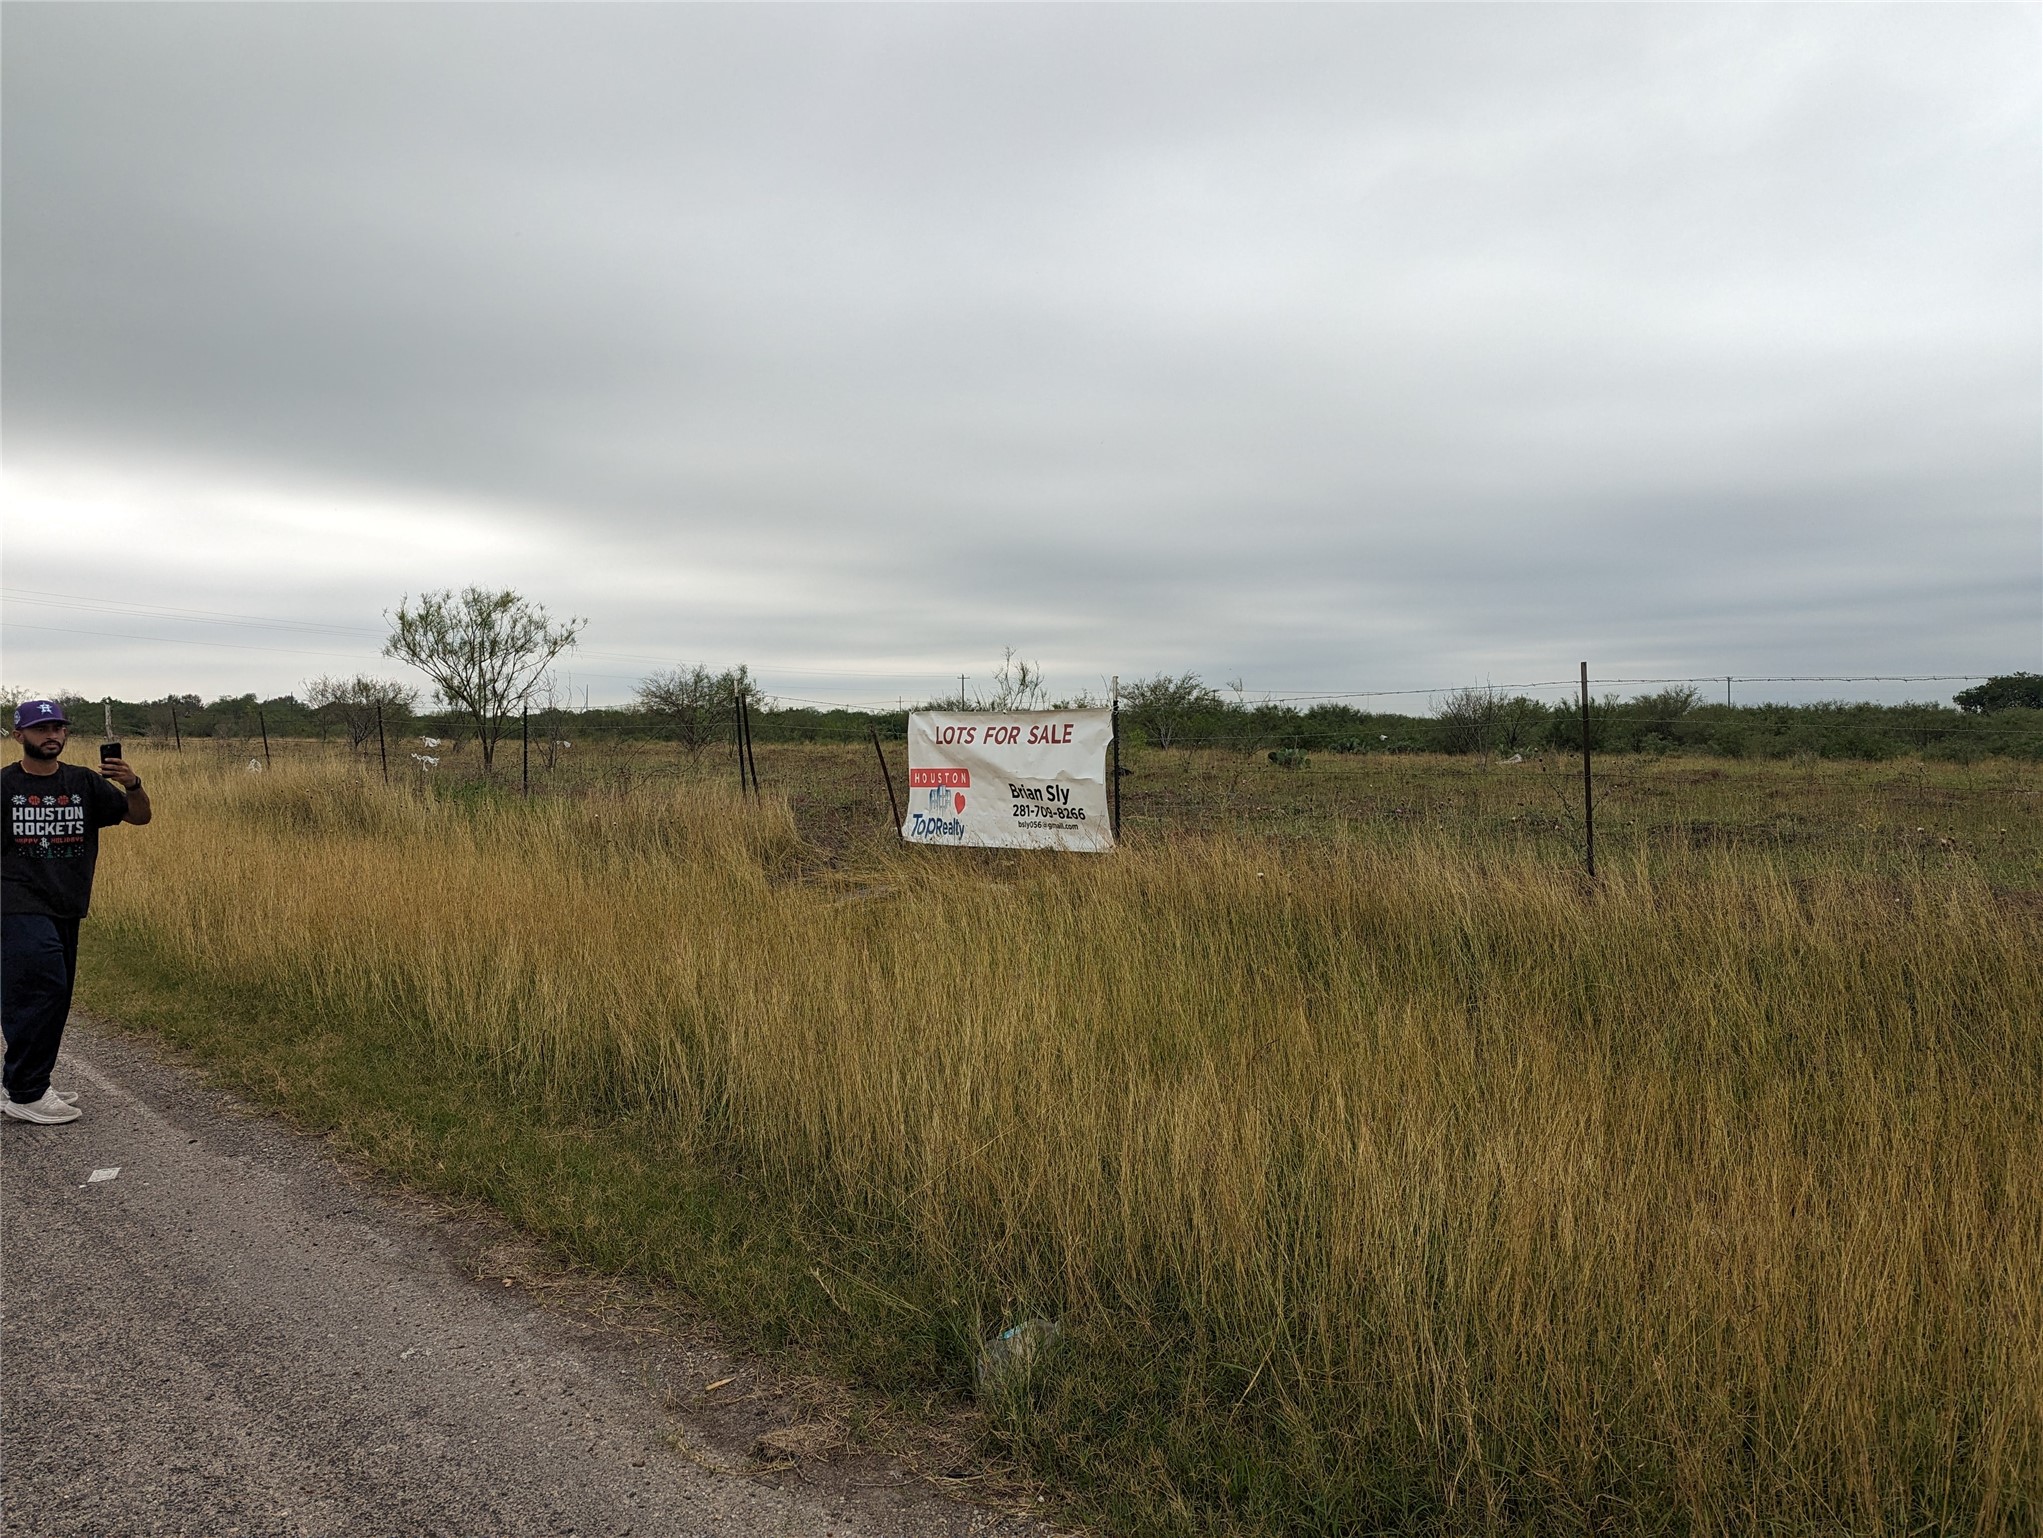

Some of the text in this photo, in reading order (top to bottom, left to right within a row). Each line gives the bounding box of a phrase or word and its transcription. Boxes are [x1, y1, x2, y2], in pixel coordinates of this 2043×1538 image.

[935, 724, 1074, 745] LOTS FOR SALE
[914, 772, 967, 784] HOUSTON
[1008, 783, 1070, 806] Brian Sly
[12, 806, 84, 821] HOUSTON
[1012, 804, 1086, 821] 281-709-8266
[12, 821, 84, 836] ROCKETS
